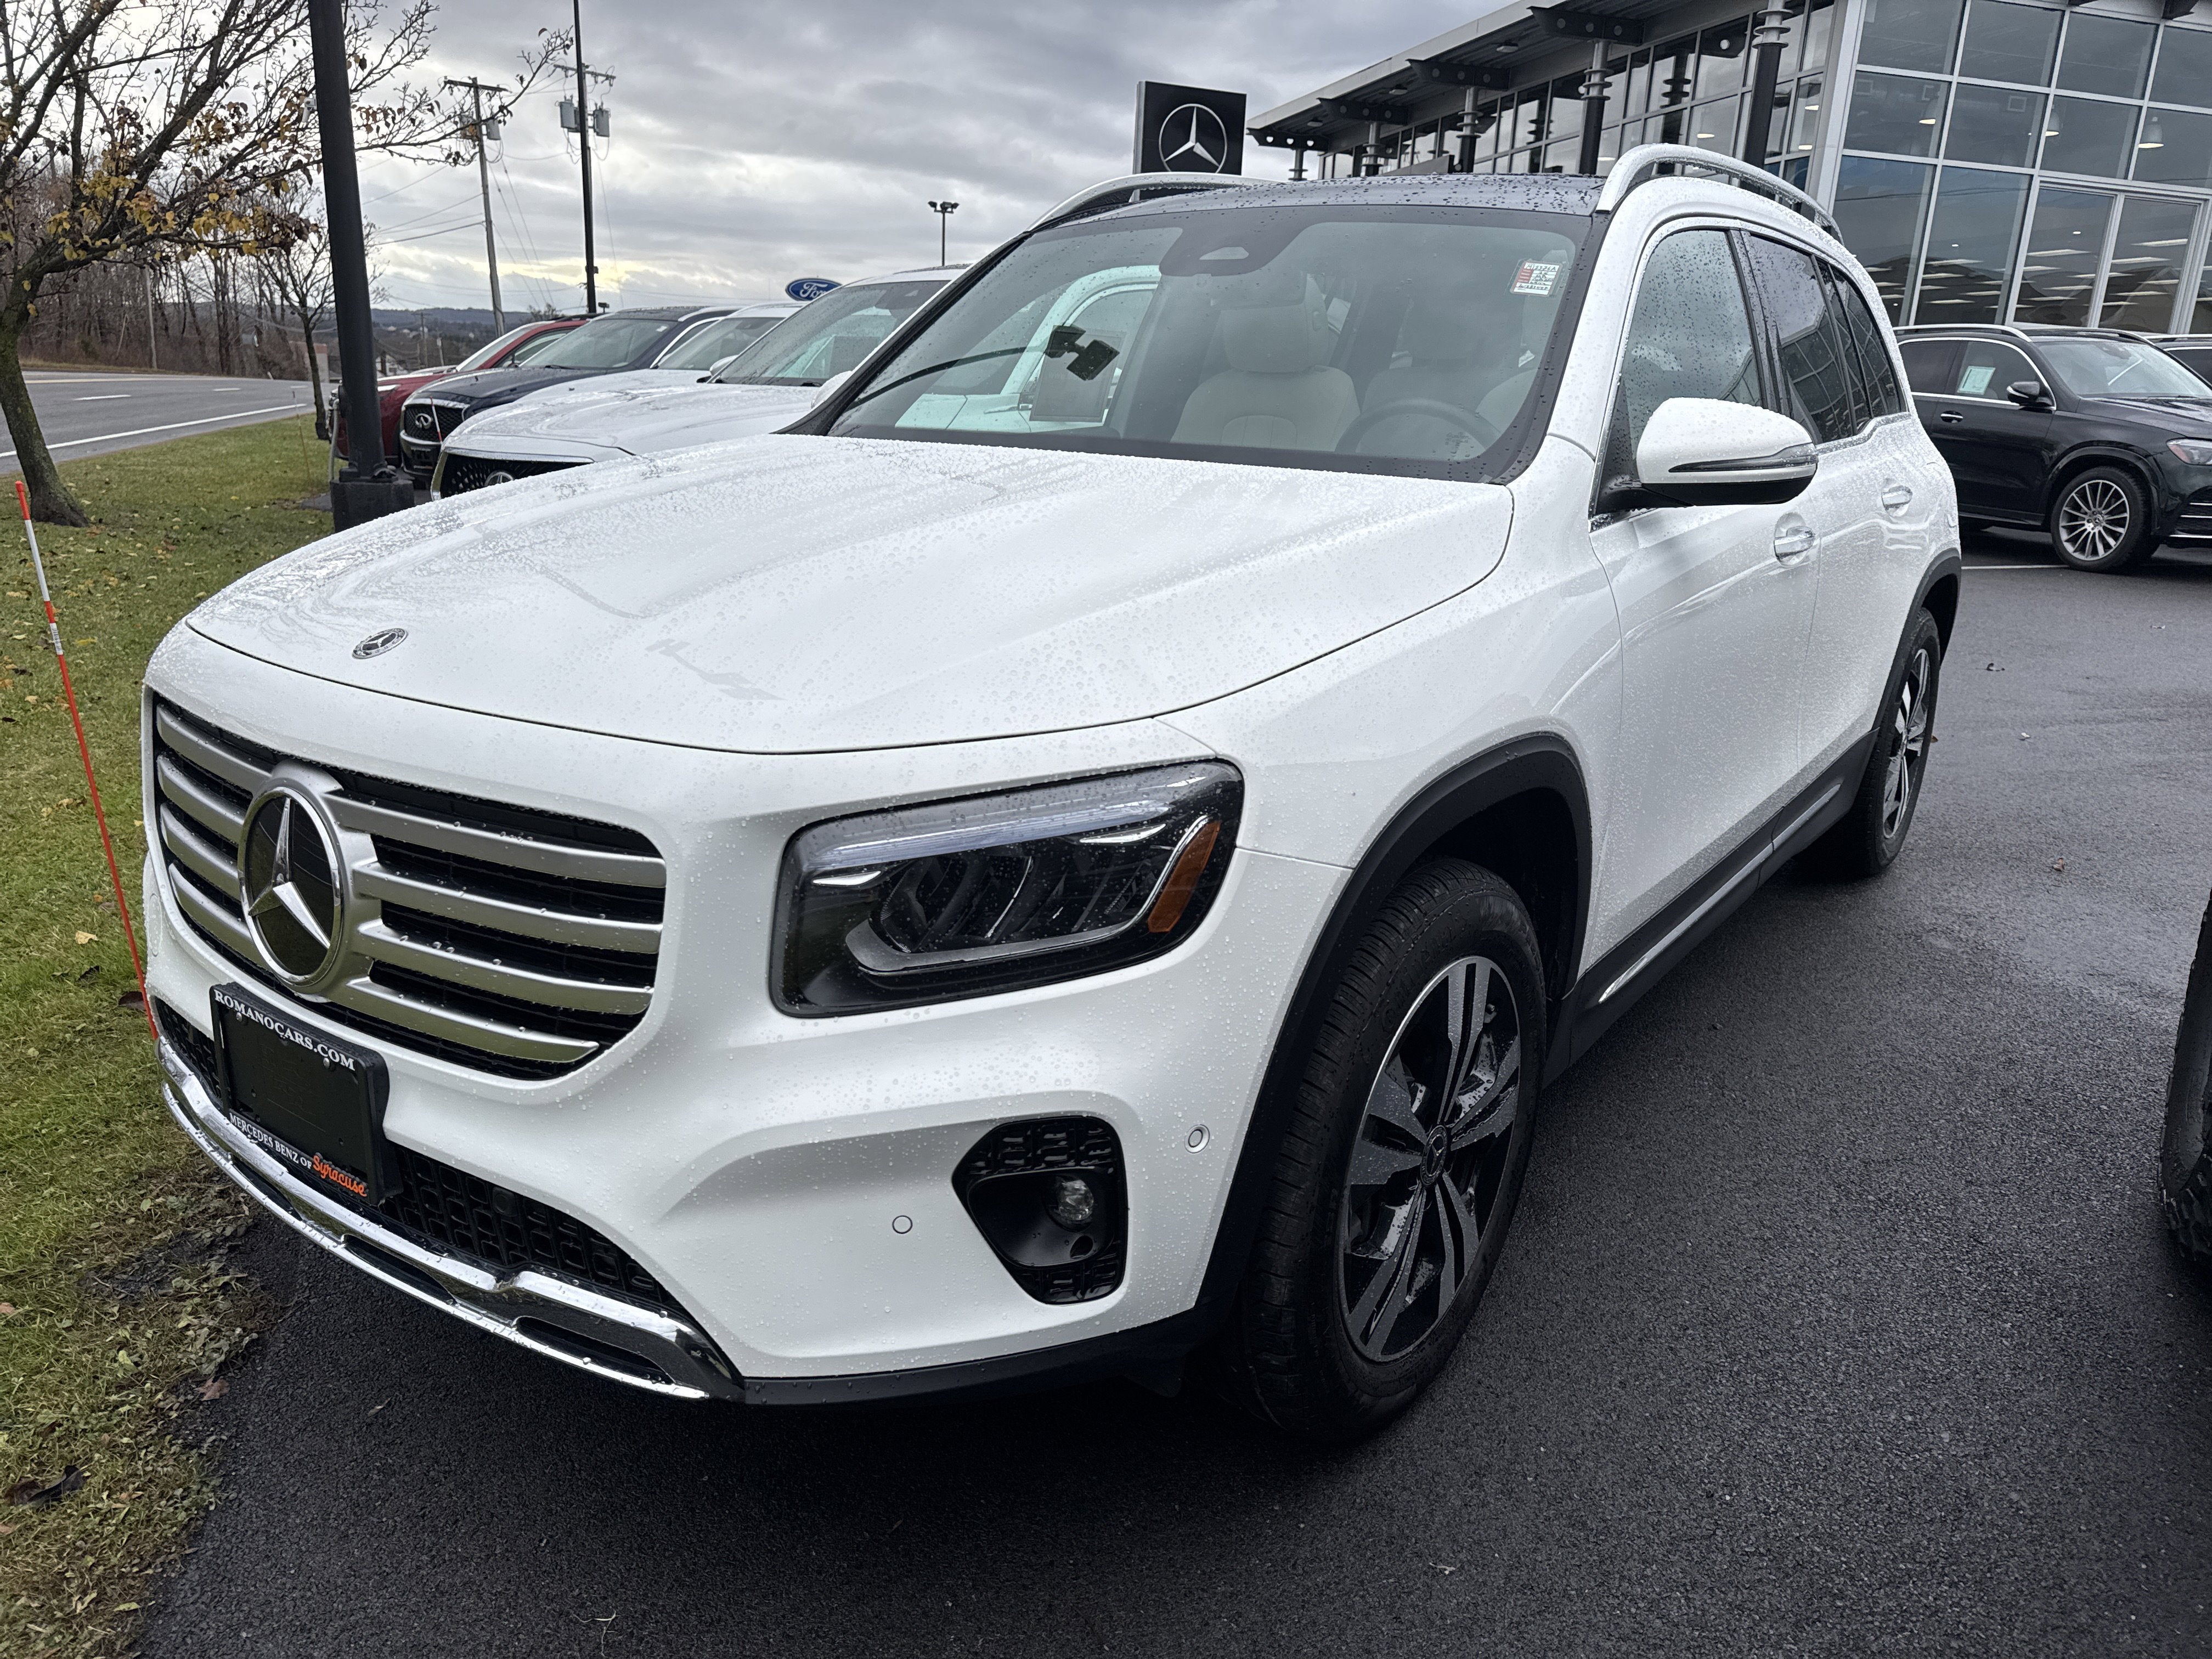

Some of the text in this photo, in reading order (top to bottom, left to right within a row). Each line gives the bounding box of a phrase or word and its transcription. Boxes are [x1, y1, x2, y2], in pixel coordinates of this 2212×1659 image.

[800, 283, 828, 298] For
[213, 989, 356, 1071] ROMANOCARS.COM
[229, 1113, 367, 1197] MERCEDES BENZ OF Syracuse
